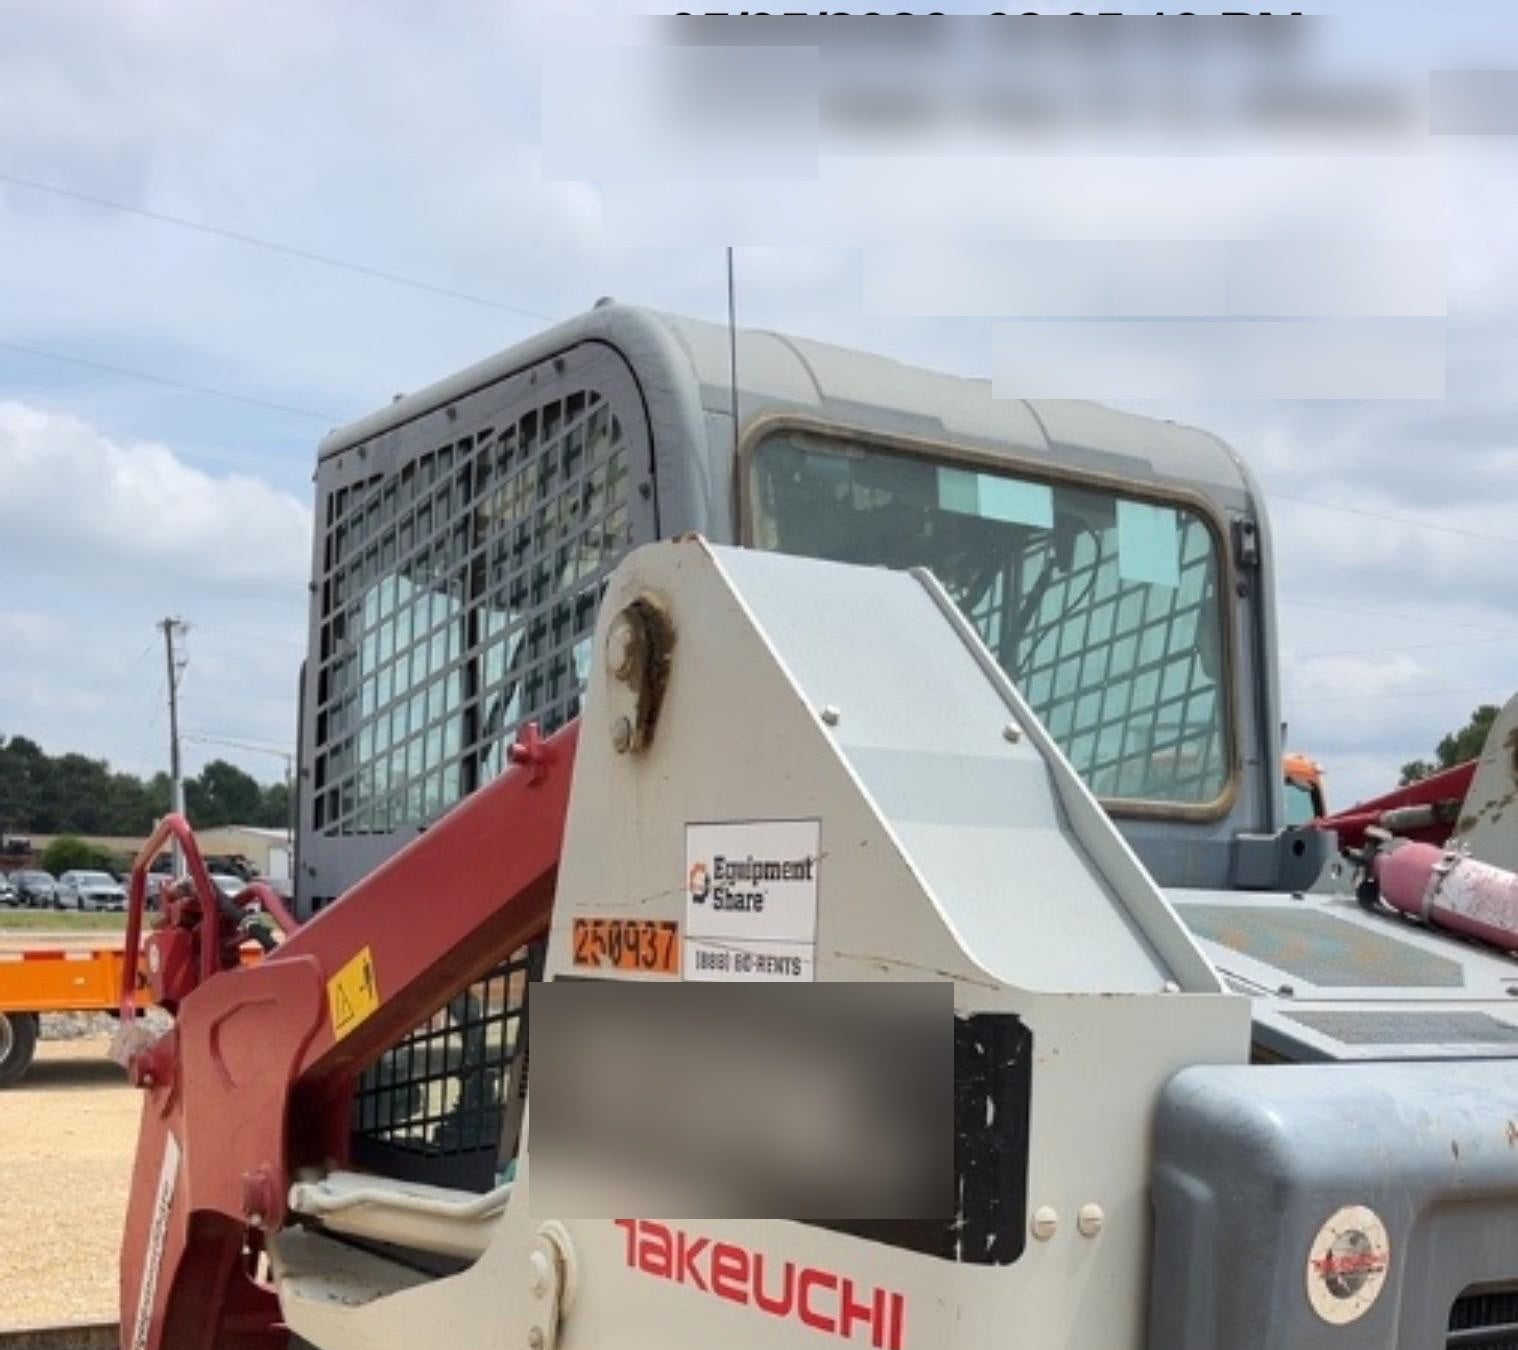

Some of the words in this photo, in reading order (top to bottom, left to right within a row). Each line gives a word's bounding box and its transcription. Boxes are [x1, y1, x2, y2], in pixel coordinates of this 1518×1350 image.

[714, 855, 813, 886] Equipment
[713, 887, 763, 912] Share
[573, 919, 678, 969] 250937
